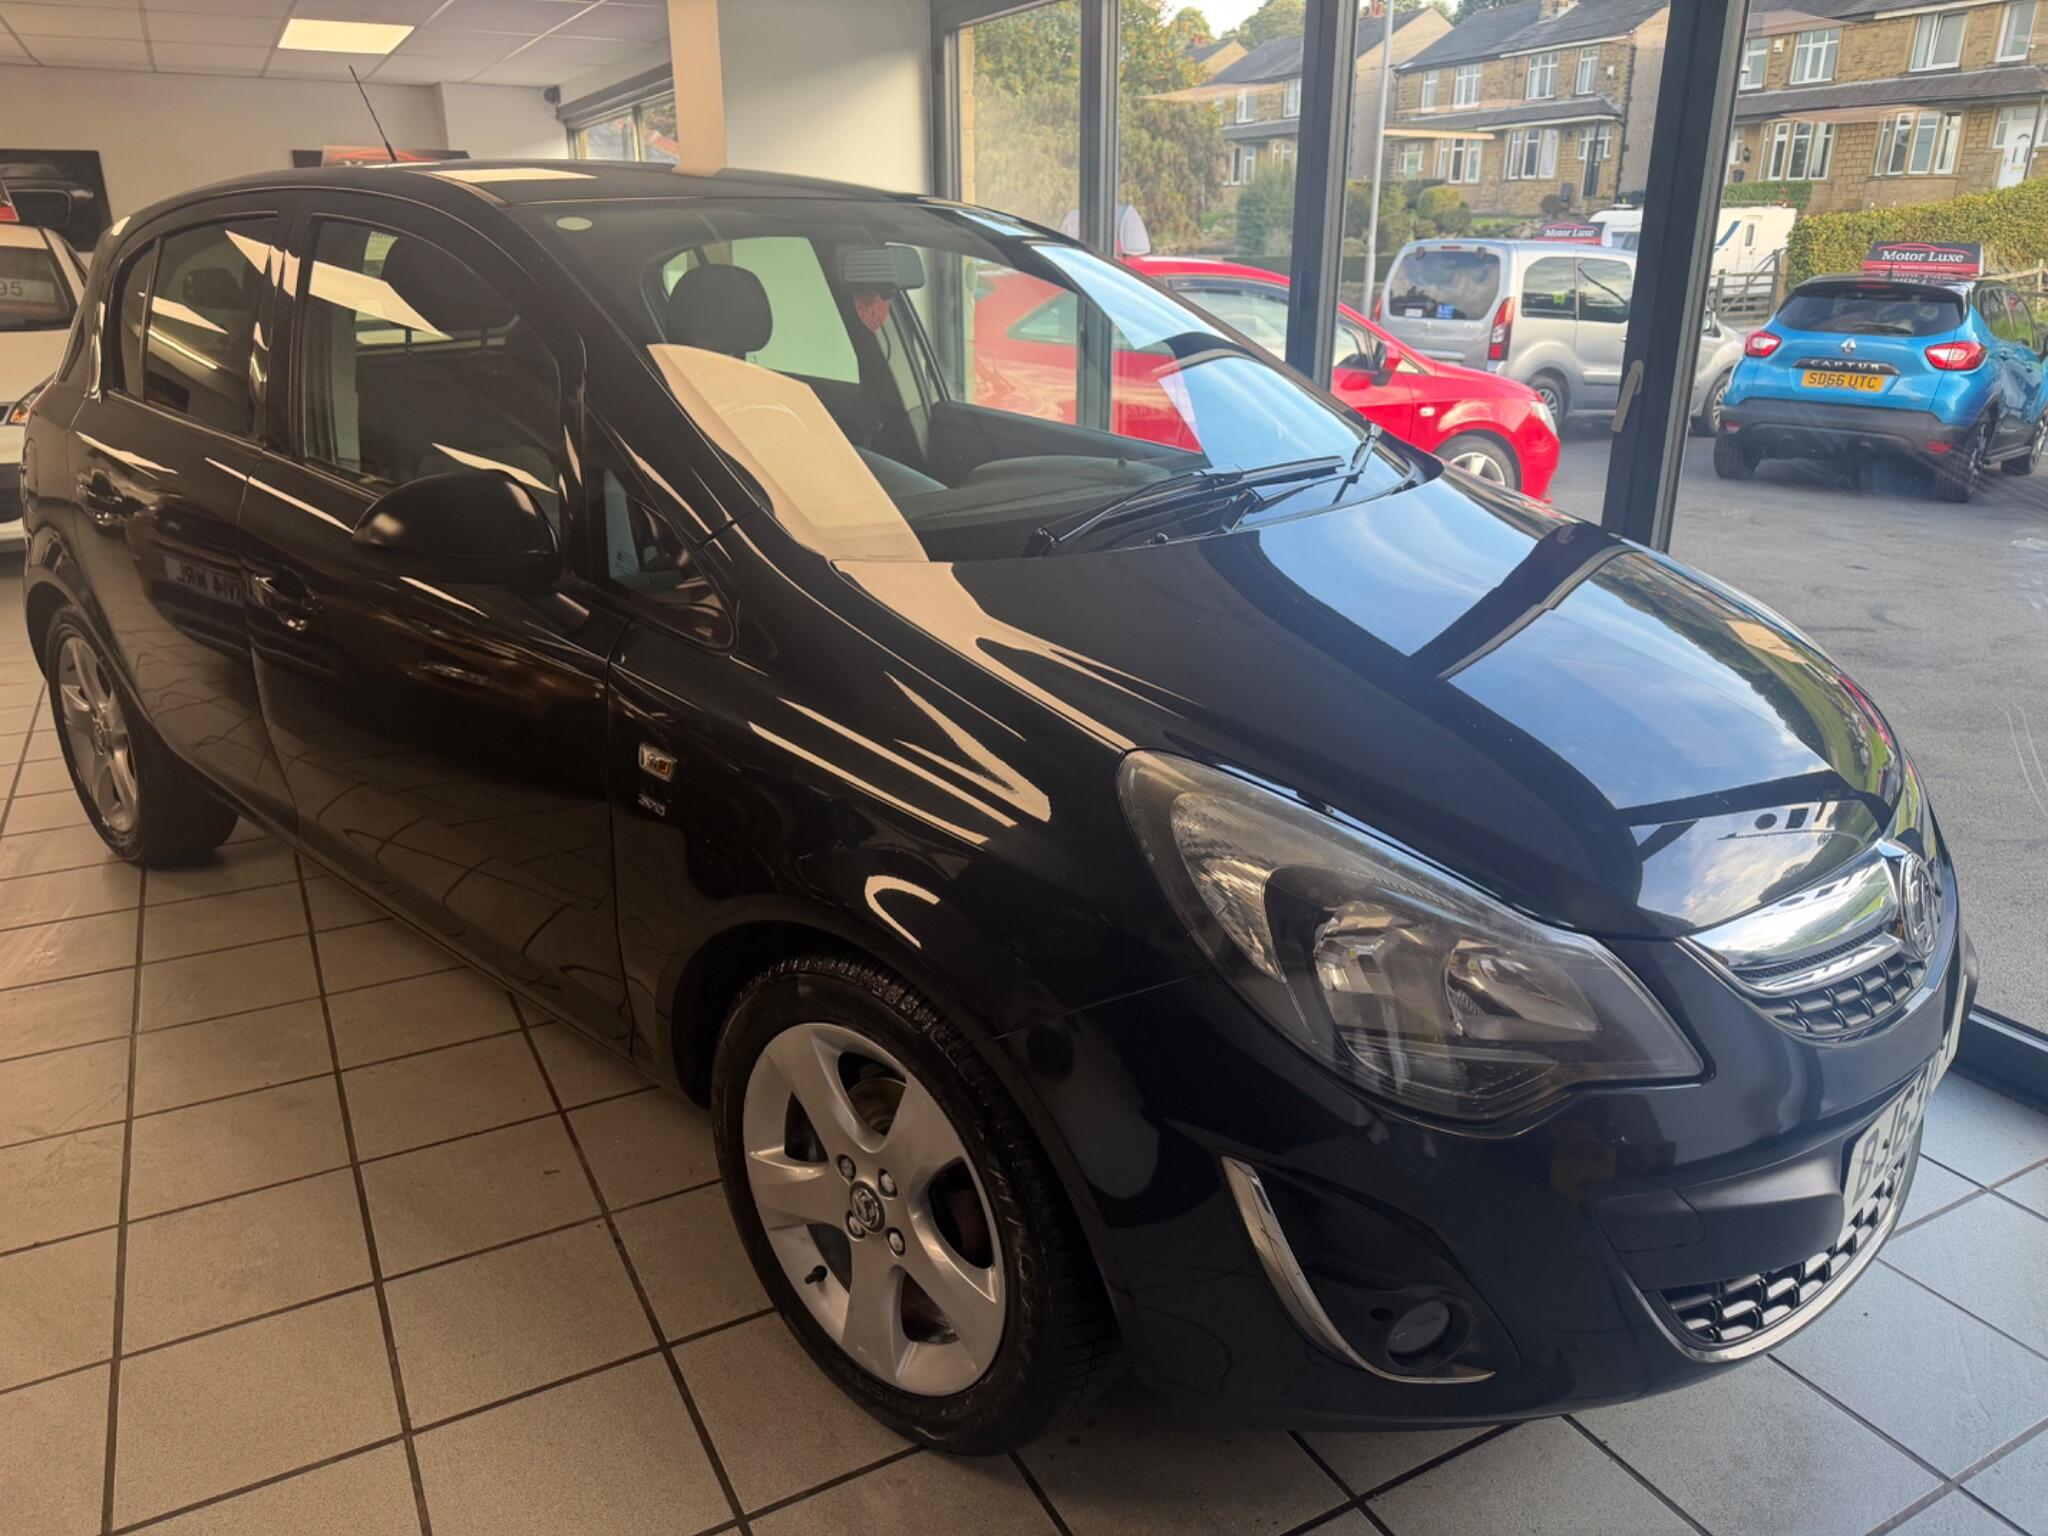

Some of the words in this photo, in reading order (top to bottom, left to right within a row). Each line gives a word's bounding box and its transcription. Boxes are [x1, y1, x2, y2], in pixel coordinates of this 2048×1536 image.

[1881, 250, 1927, 261] Motor
[1927, 251, 1965, 263] Luxe
[1810, 359, 1880, 371] CAPTUR
[1807, 372, 1845, 387] SD66
[1847, 374, 1878, 389] UTC
